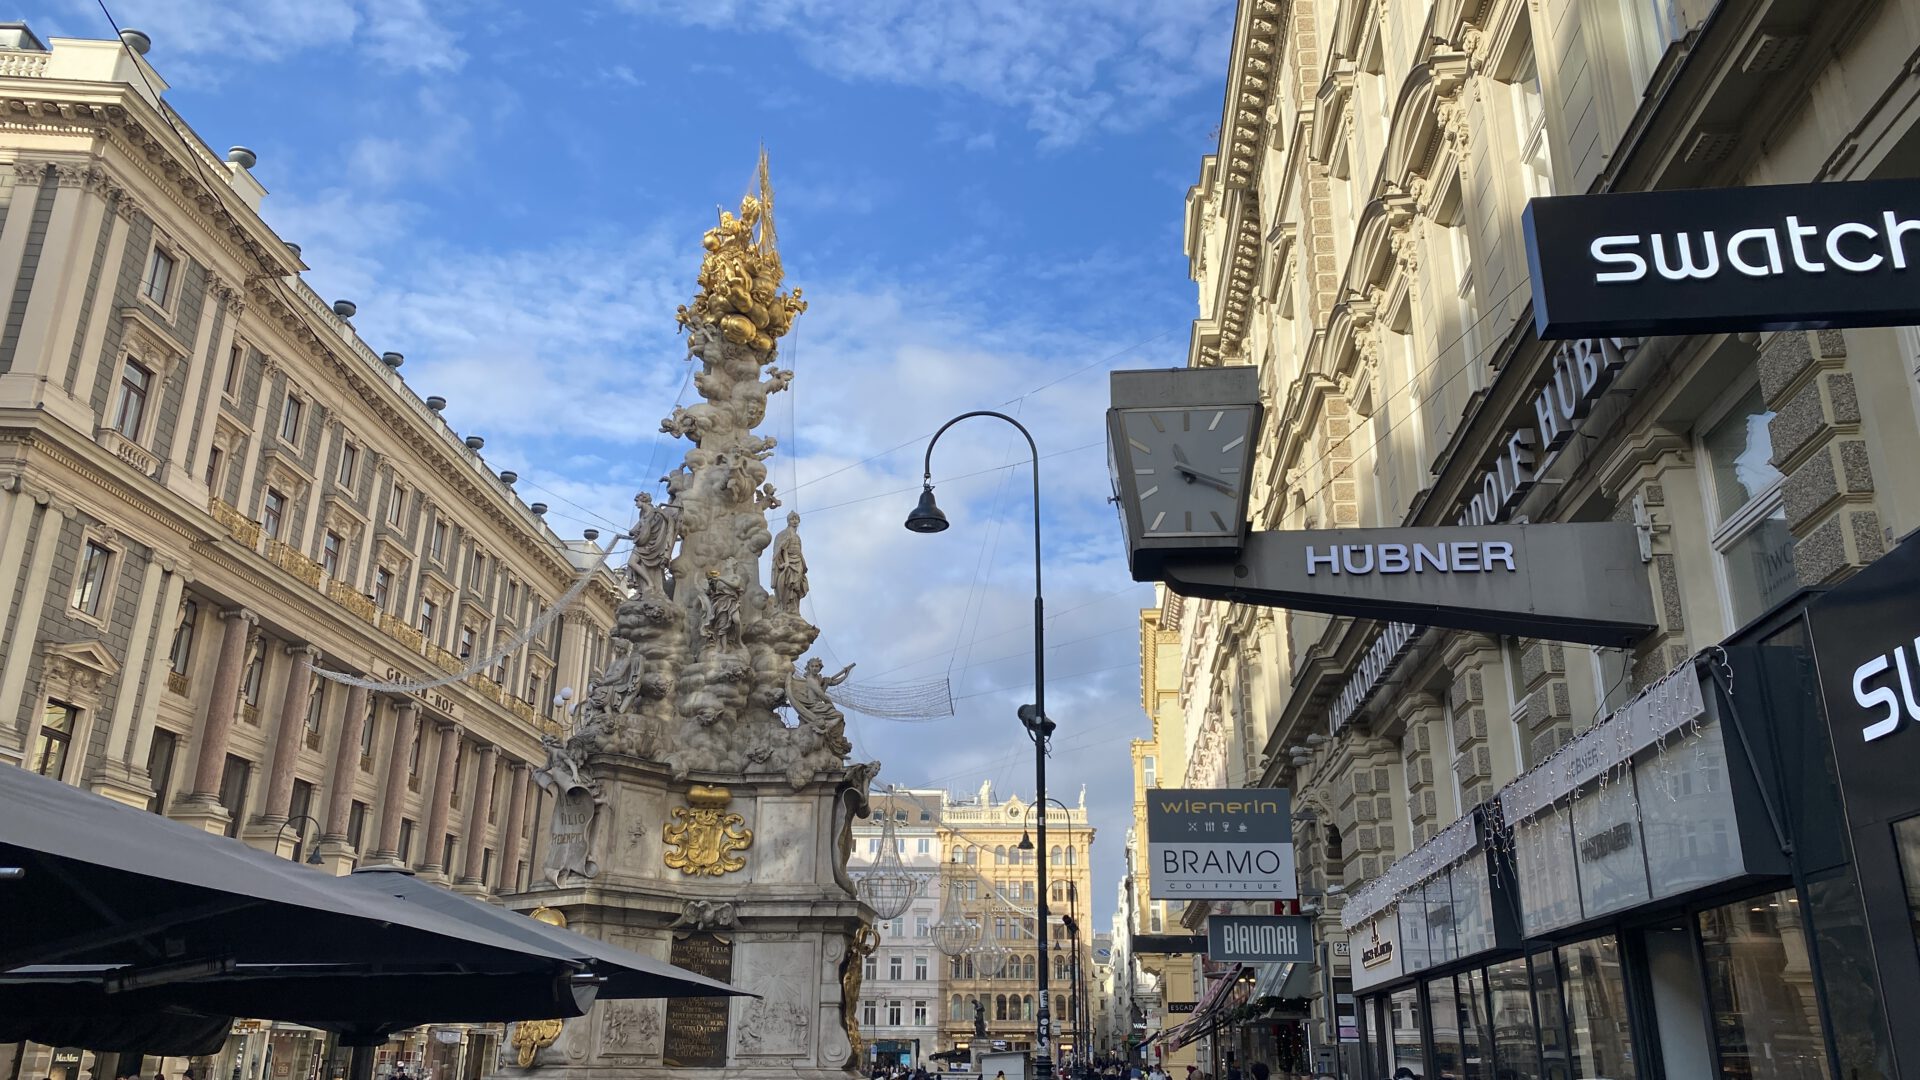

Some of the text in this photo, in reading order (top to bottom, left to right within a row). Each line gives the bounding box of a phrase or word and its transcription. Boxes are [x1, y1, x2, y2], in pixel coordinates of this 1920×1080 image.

[1590, 211, 1920, 282] swatch
[1305, 541, 1516, 575] HÜBNER
[1163, 849, 1280, 874] BRAMO
[1336, 943, 1348, 952] 27
